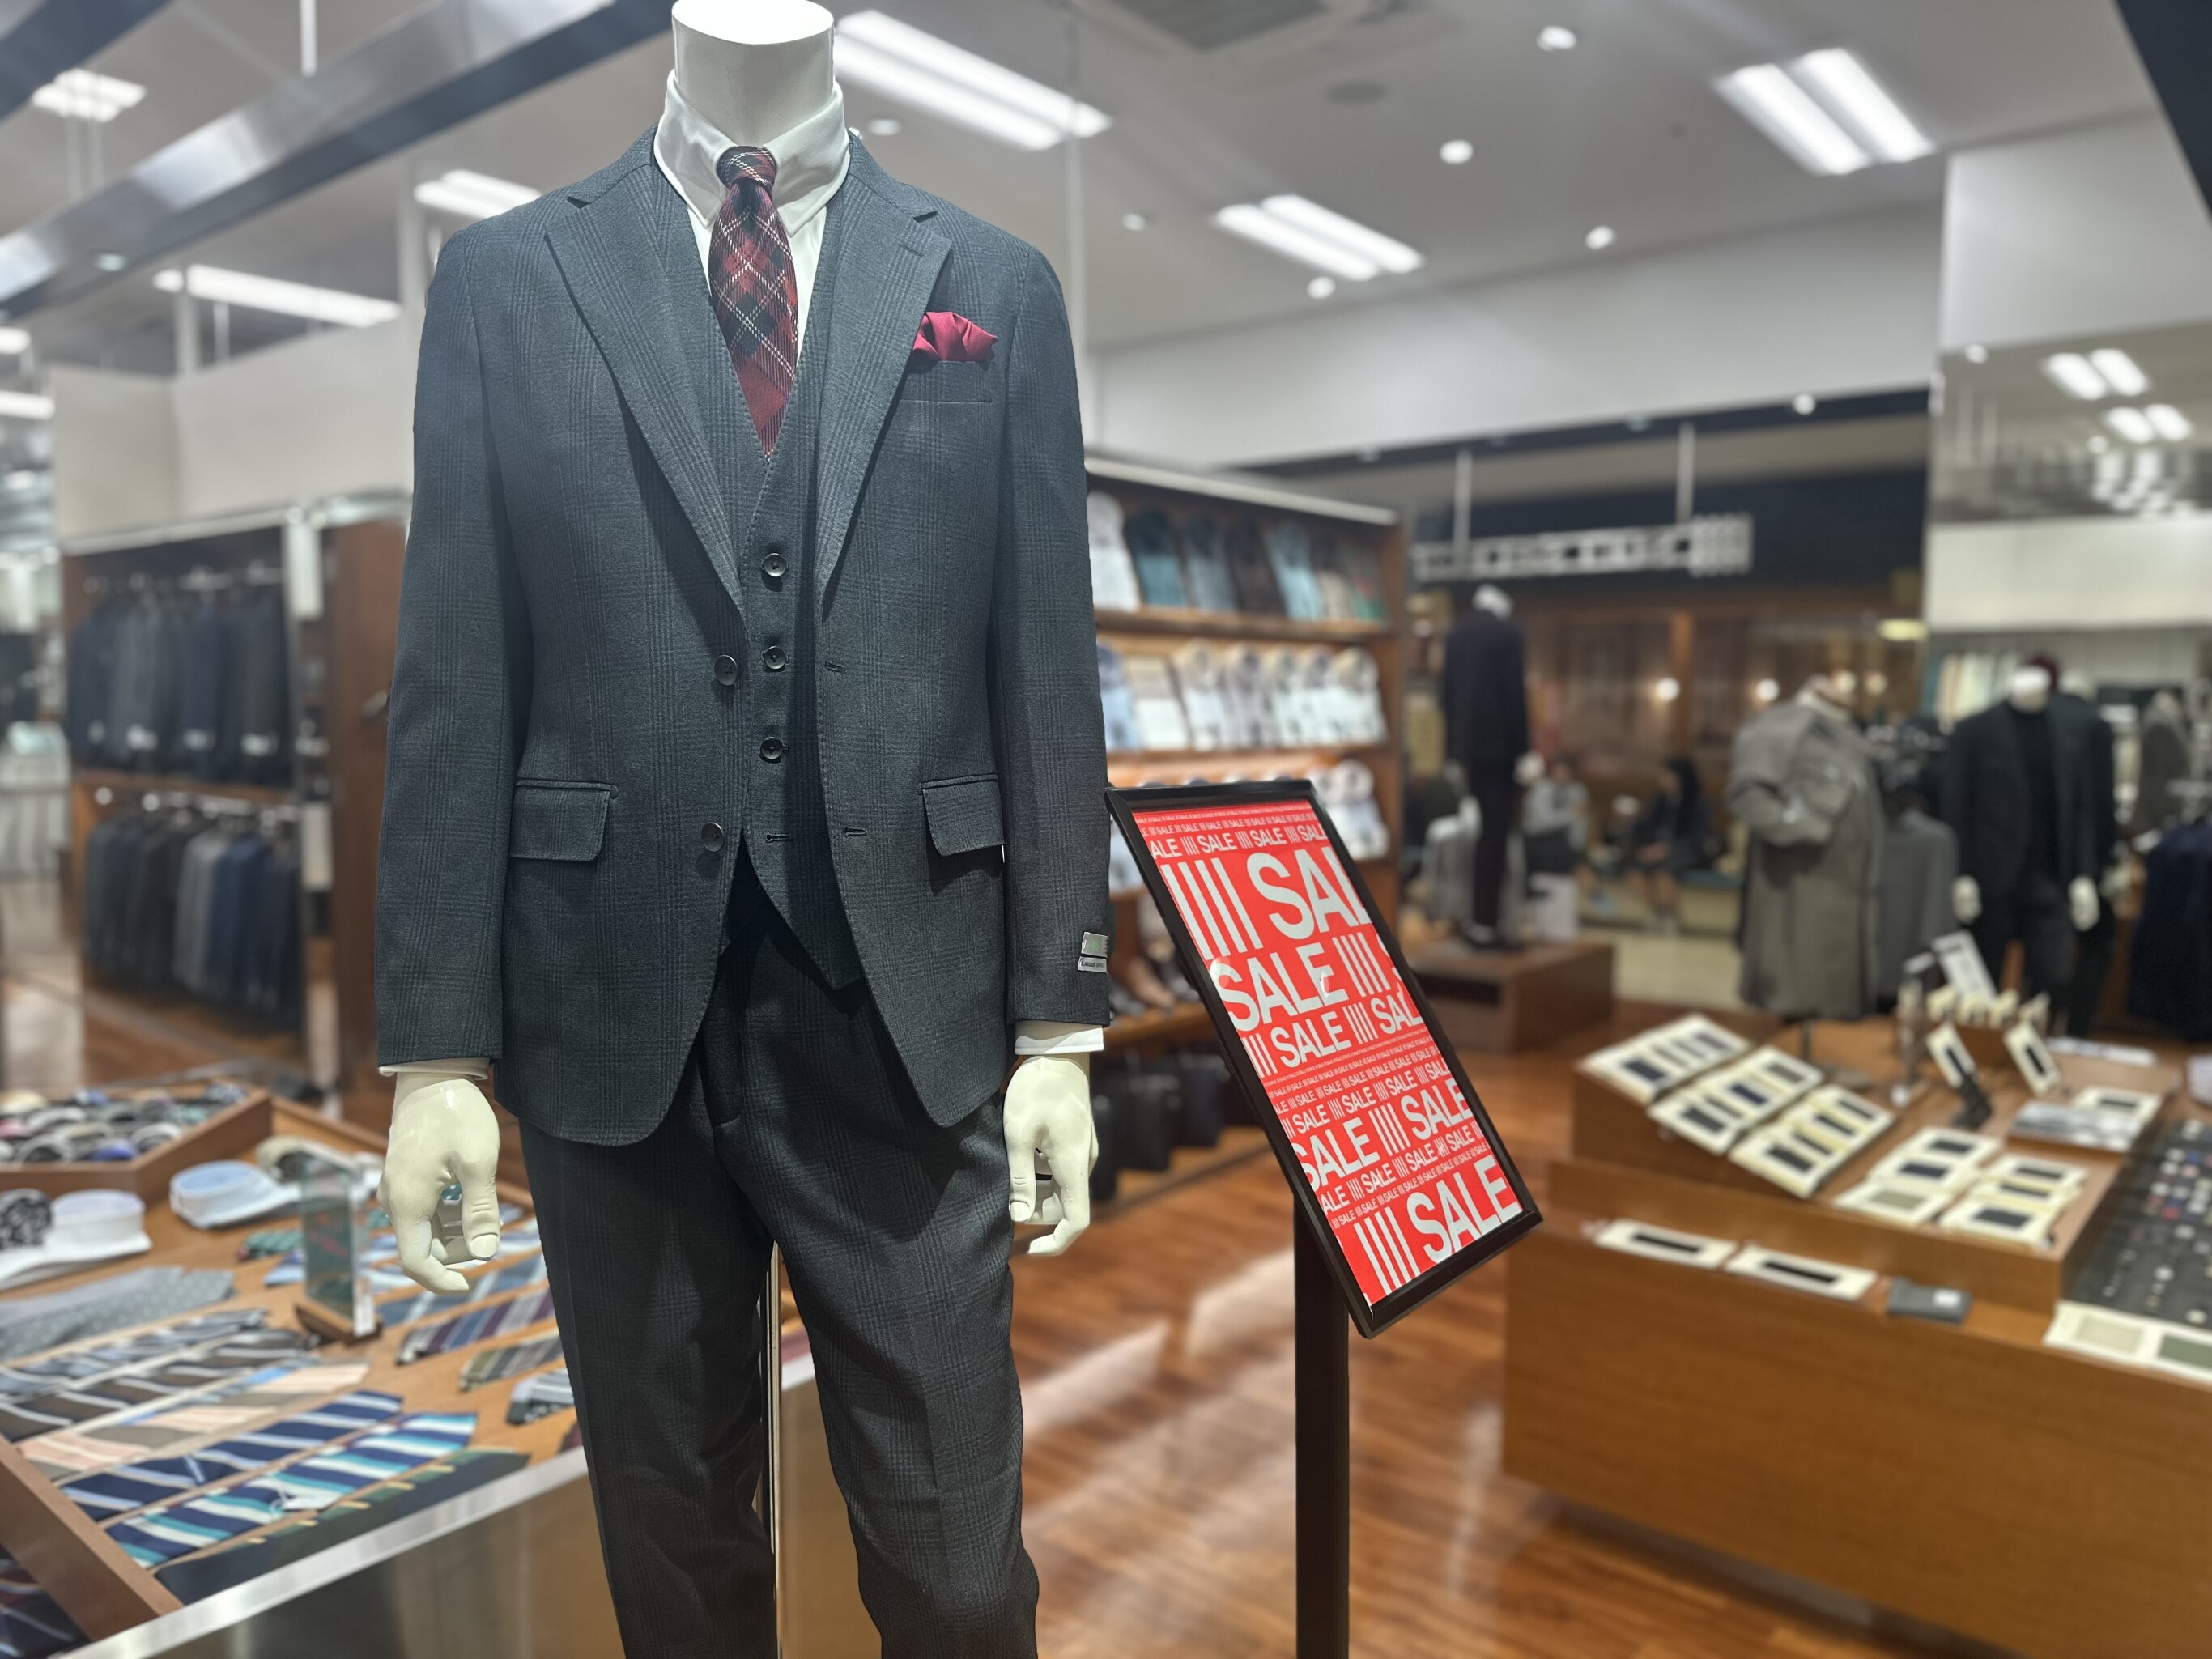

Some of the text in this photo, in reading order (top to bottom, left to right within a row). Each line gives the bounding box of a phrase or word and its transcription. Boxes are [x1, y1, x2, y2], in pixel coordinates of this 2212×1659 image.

[1149, 838, 1182, 860] ALE
[1196, 832, 1237, 853] SALE
[1249, 827, 1287, 847] SALE
[1155, 825, 1175, 835] SALE
[1180, 823, 1199, 832] SALE
[1205, 821, 1222, 829] SALE
[1227, 819, 1244, 827] SALE
[1249, 817, 1266, 825] SALE
[1270, 815, 1287, 823] SALE
[1206, 942, 1349, 1032] SALE
[1270, 1010, 1351, 1067] SALE
[1291, 1104, 1330, 1134] SALE
[1341, 1086, 1376, 1113] SALE
[1385, 1070, 1418, 1095] SALE
[1295, 1090, 1317, 1106] SALE
[1322, 1080, 1342, 1095] SALE
[1348, 1071, 1367, 1086] SALE
[1372, 1062, 1390, 1076] SALE
[1393, 1055, 1411, 1068] SALE
[1415, 1048, 1431, 1060] SALE
[1320, 1125, 1475, 1214] ALE SALE SALE SALE
[1338, 1142, 1487, 1225] SALE SALE SALE SALE SALE SALE SALE SALE
[1406, 1154, 1522, 1264] SALE
